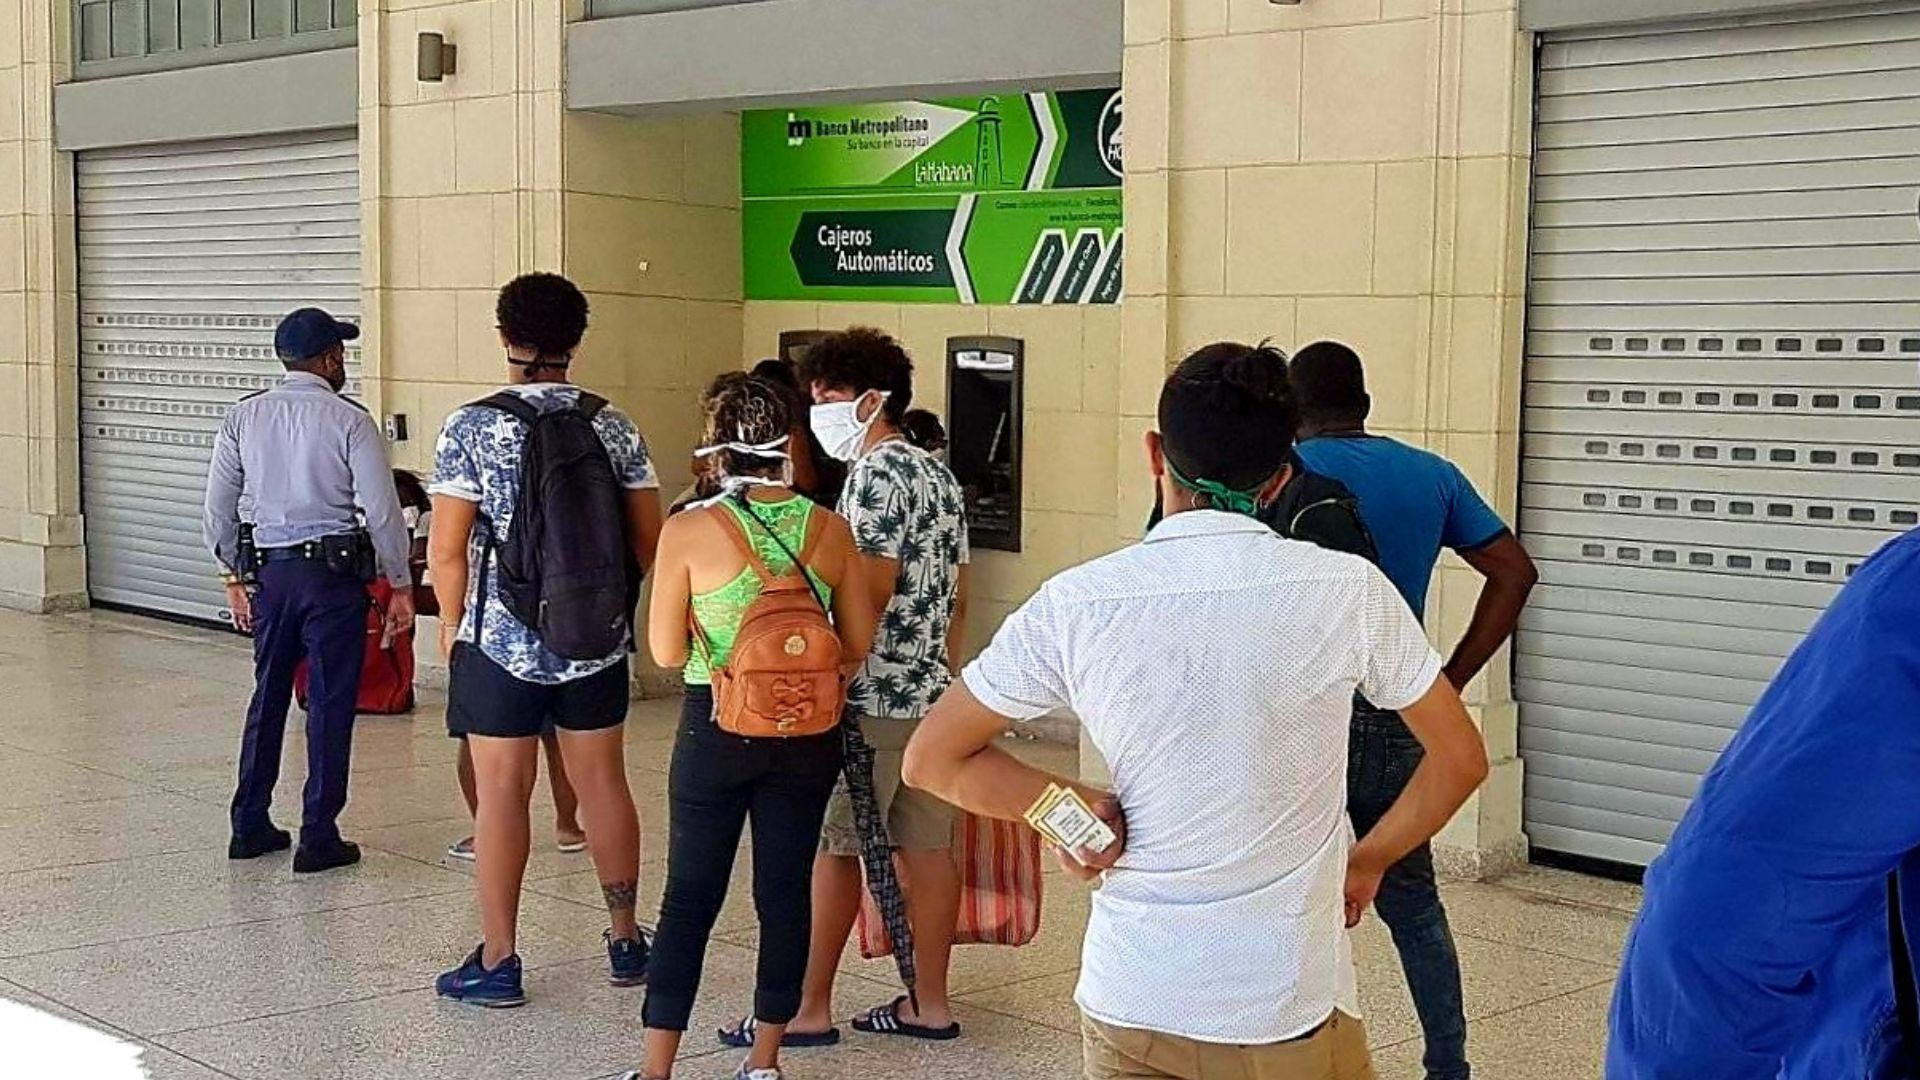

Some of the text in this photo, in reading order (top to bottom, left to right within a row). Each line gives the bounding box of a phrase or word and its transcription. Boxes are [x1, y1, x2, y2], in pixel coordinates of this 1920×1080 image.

[816, 115, 929, 137] Banco Metropolitano
[818, 225, 872, 252] Cajeros
[837, 249, 934, 272] Automáticos
